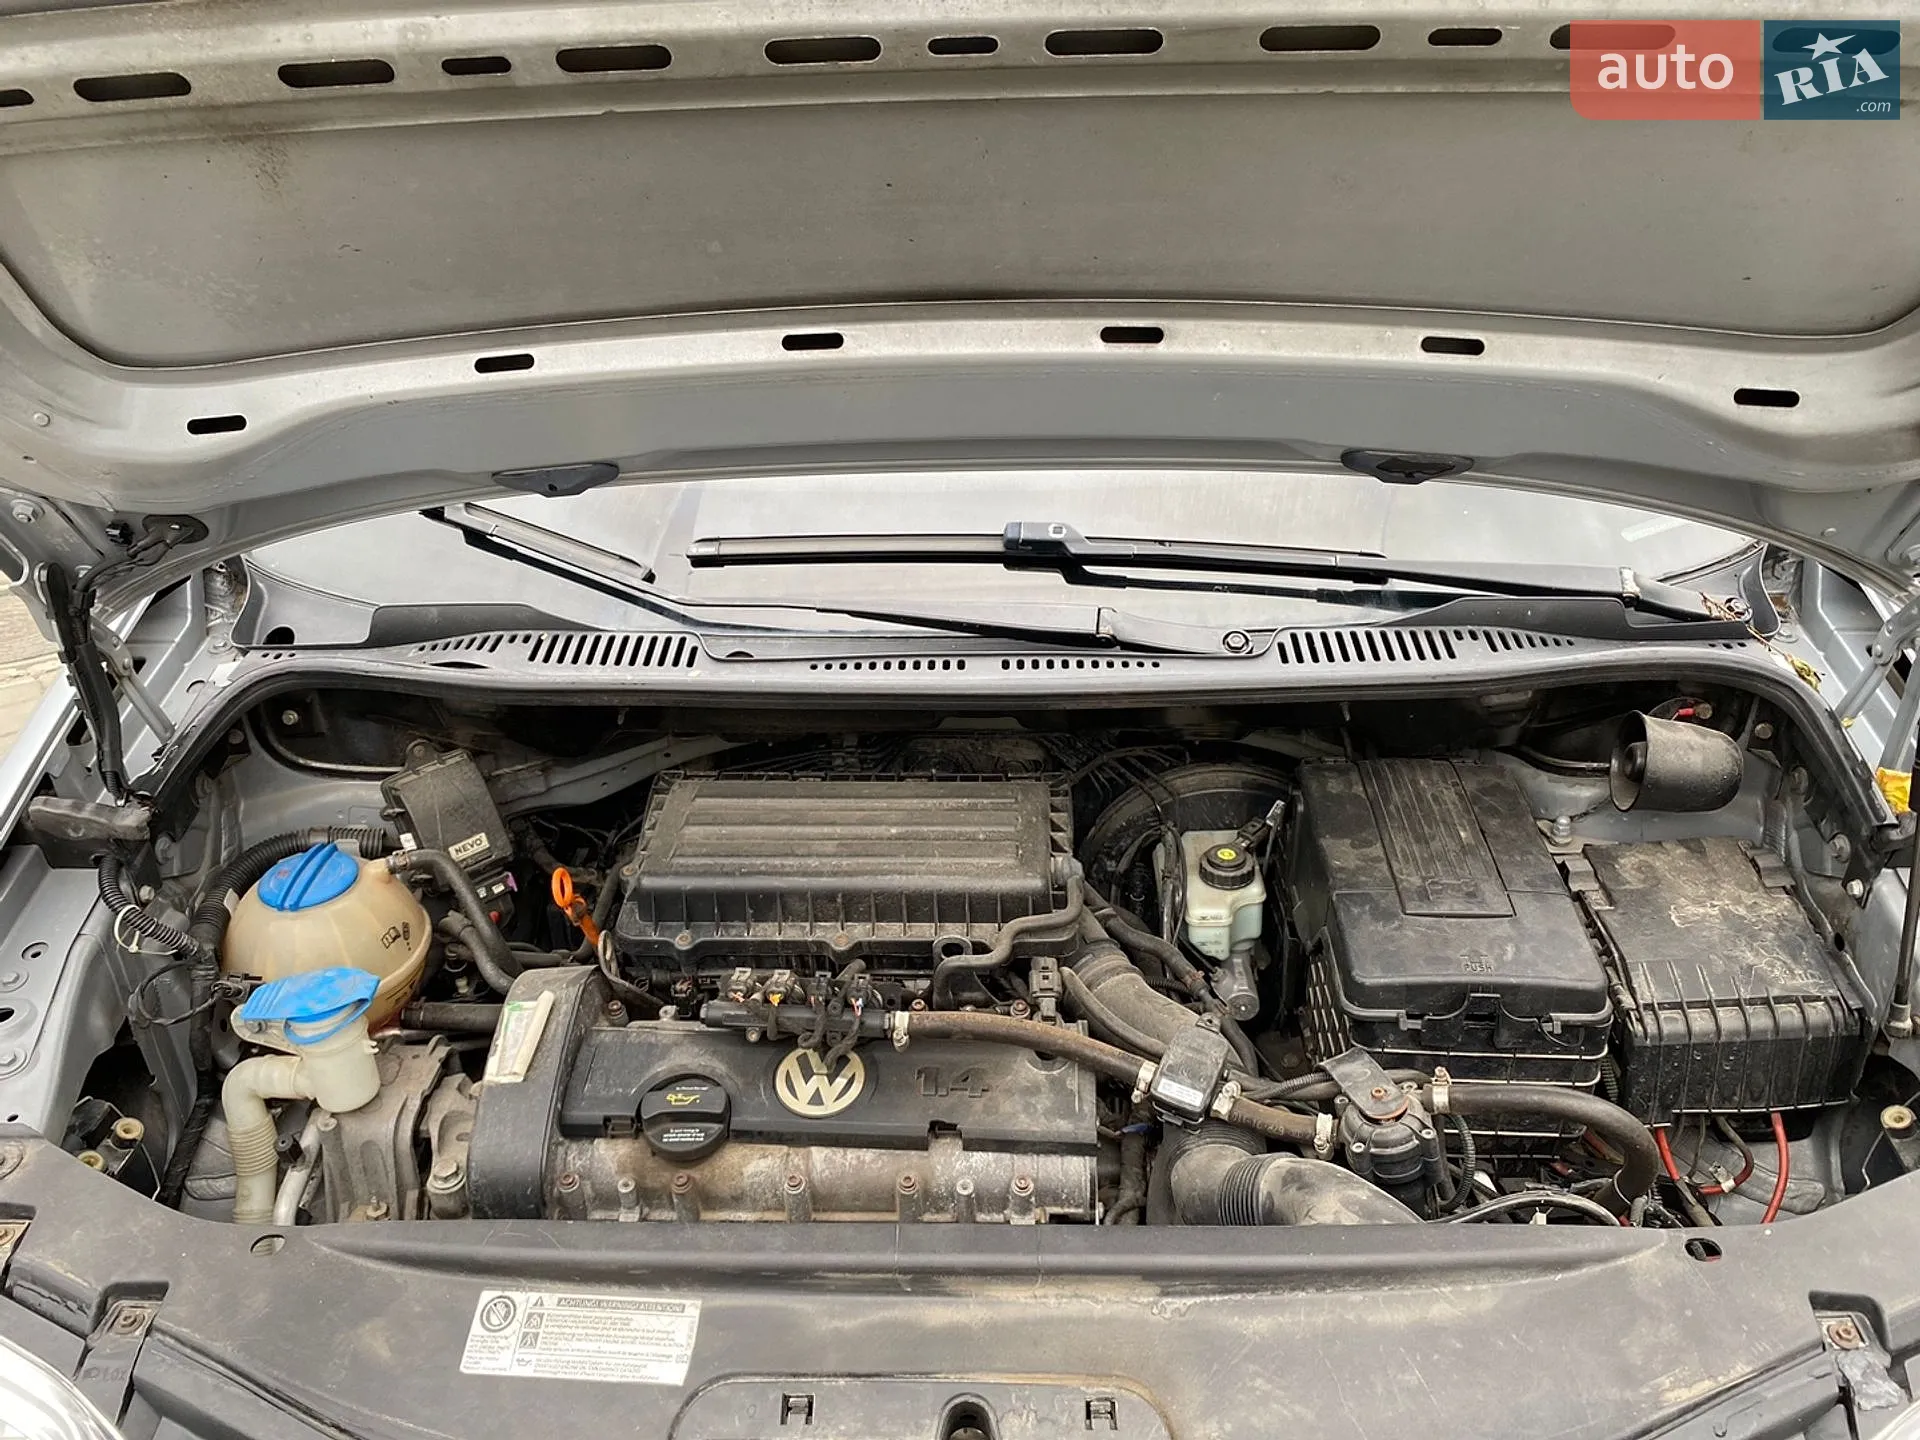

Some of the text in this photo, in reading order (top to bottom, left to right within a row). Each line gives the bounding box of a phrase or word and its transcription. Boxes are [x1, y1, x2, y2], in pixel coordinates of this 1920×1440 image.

[454, 837, 483, 855] NEVO
[1464, 963, 1493, 973] PUSH
[915, 1066, 990, 1098] 1.4
